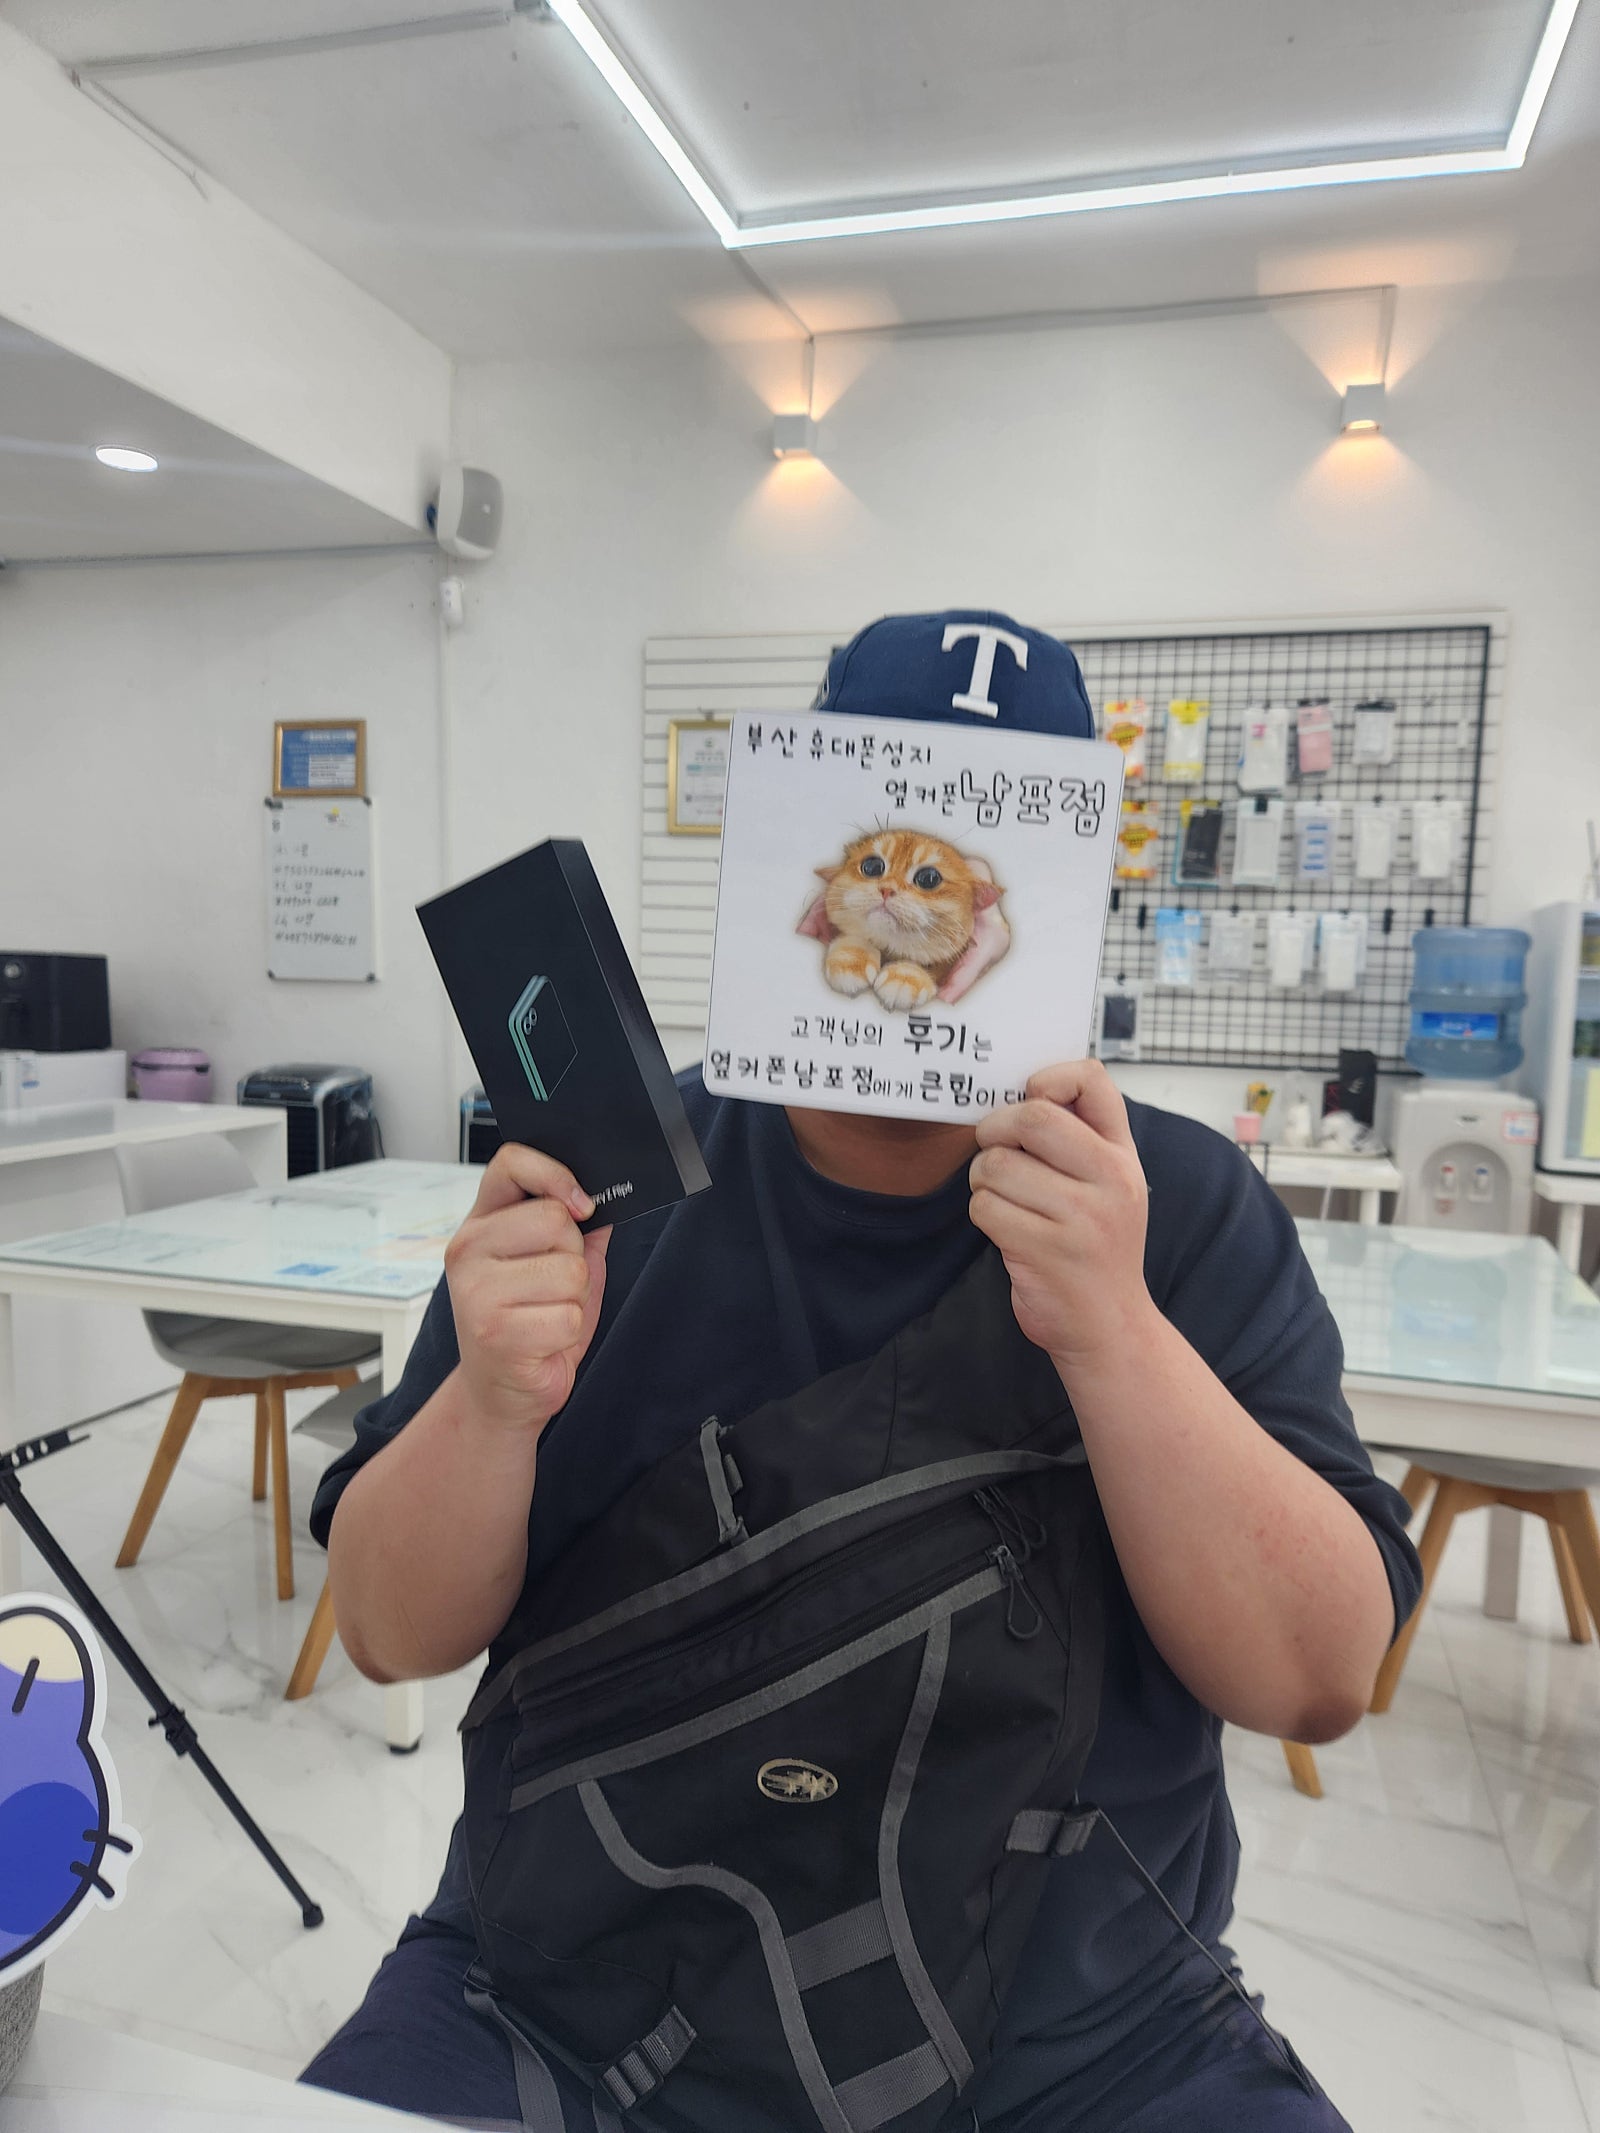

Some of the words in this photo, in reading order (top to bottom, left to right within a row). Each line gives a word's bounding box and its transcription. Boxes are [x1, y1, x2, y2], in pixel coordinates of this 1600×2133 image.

[941, 623, 1028, 719] T
[748, 722, 798, 758] 부산
[791, 1015, 883, 1047] 고객님의
[903, 1013, 993, 1062] 후기는
